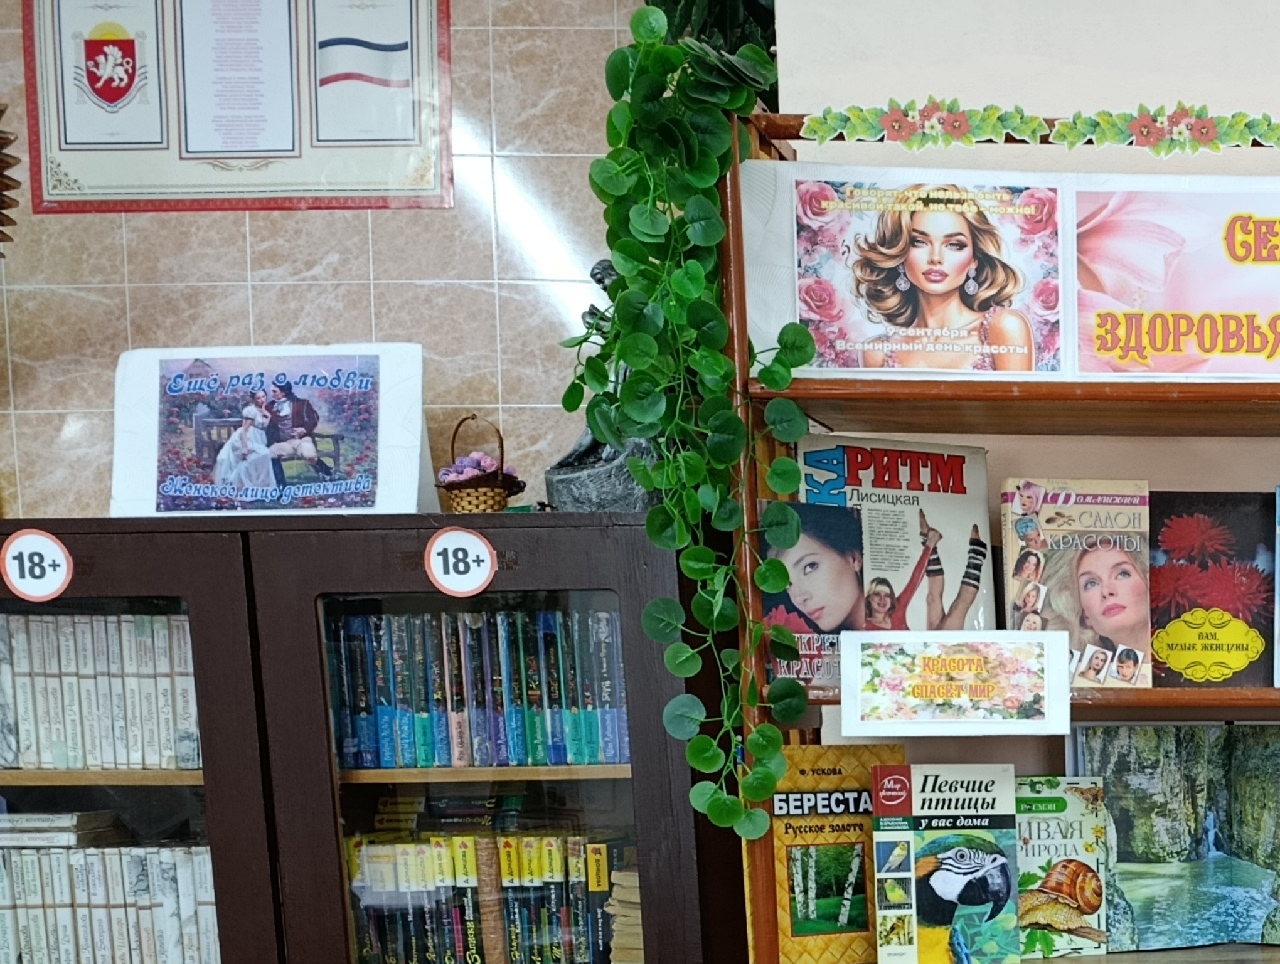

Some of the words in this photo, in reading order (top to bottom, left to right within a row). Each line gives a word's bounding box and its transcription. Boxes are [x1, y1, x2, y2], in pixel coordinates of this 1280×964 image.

[899, 328, 968, 340] сентября
[835, 340, 923, 354] Всемирный
[926, 343, 961, 354] день
[964, 343, 1028, 356] красоты
[164, 372, 219, 396] Ещё
[223, 371, 266, 394] раз
[293, 367, 374, 392] любви
[845, 445, 968, 495] РИТМ
[159, 474, 237, 500] Женское
[238, 485, 280, 501] лицо
[279, 475, 373, 506] детектива
[848, 488, 921, 506] Лисицкая
[1078, 511, 1142, 530] САЛОН
[1047, 534, 1142, 552] КРАСОТЫ
[11, 551, 61, 580] 18+
[436, 547, 486, 577] 18+
[921, 657, 985, 675] КРАСОТА
[967, 684, 996, 699] МИР
[811, 767, 844, 777] УСКОВА
[919, 774, 996, 795] Певчие
[773, 791, 873, 816] БЕРЕСТА
[919, 797, 997, 813] птицы
[783, 822, 827, 837] Русское
[829, 821, 865, 834] золото
[930, 817, 953, 828] вас
[956, 815, 989, 829] дома
